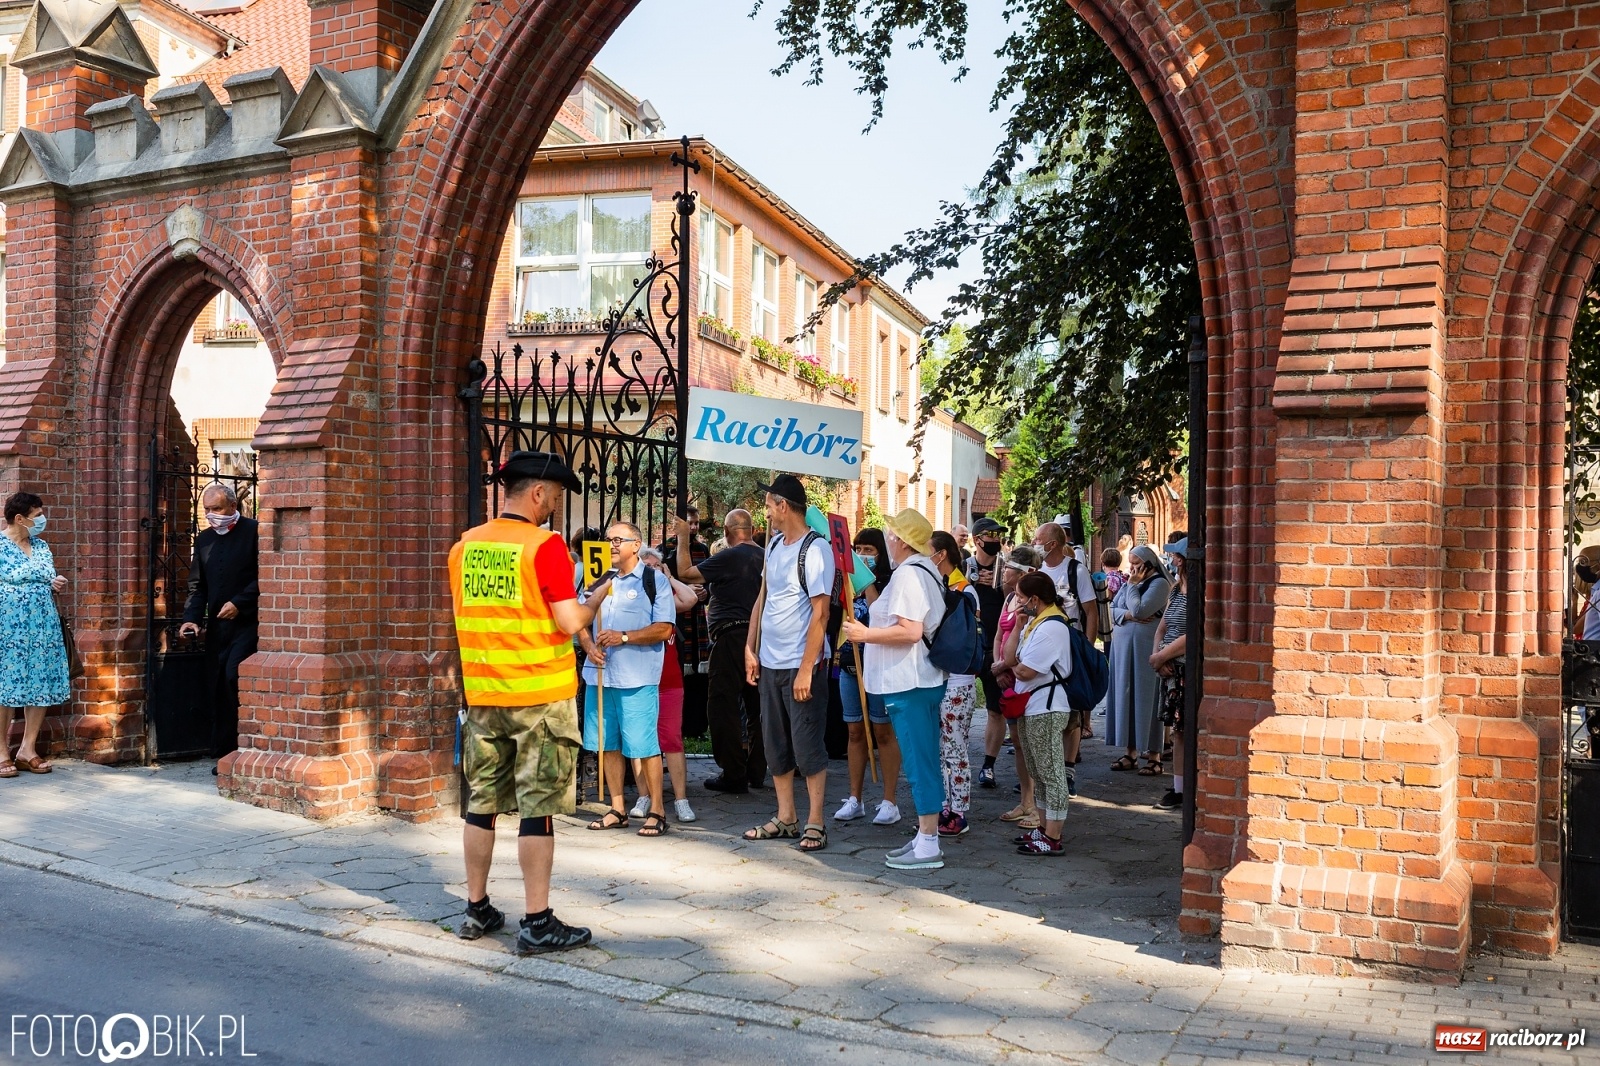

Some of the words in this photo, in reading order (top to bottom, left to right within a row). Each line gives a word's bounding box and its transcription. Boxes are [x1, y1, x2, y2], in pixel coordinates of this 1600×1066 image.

[692, 406, 858, 465] Racibórz
[833, 519, 846, 554] 5
[465, 549, 517, 571] KIEROWANIE
[590, 546, 603, 579] 5
[465, 573, 516, 600] RUCHEM
